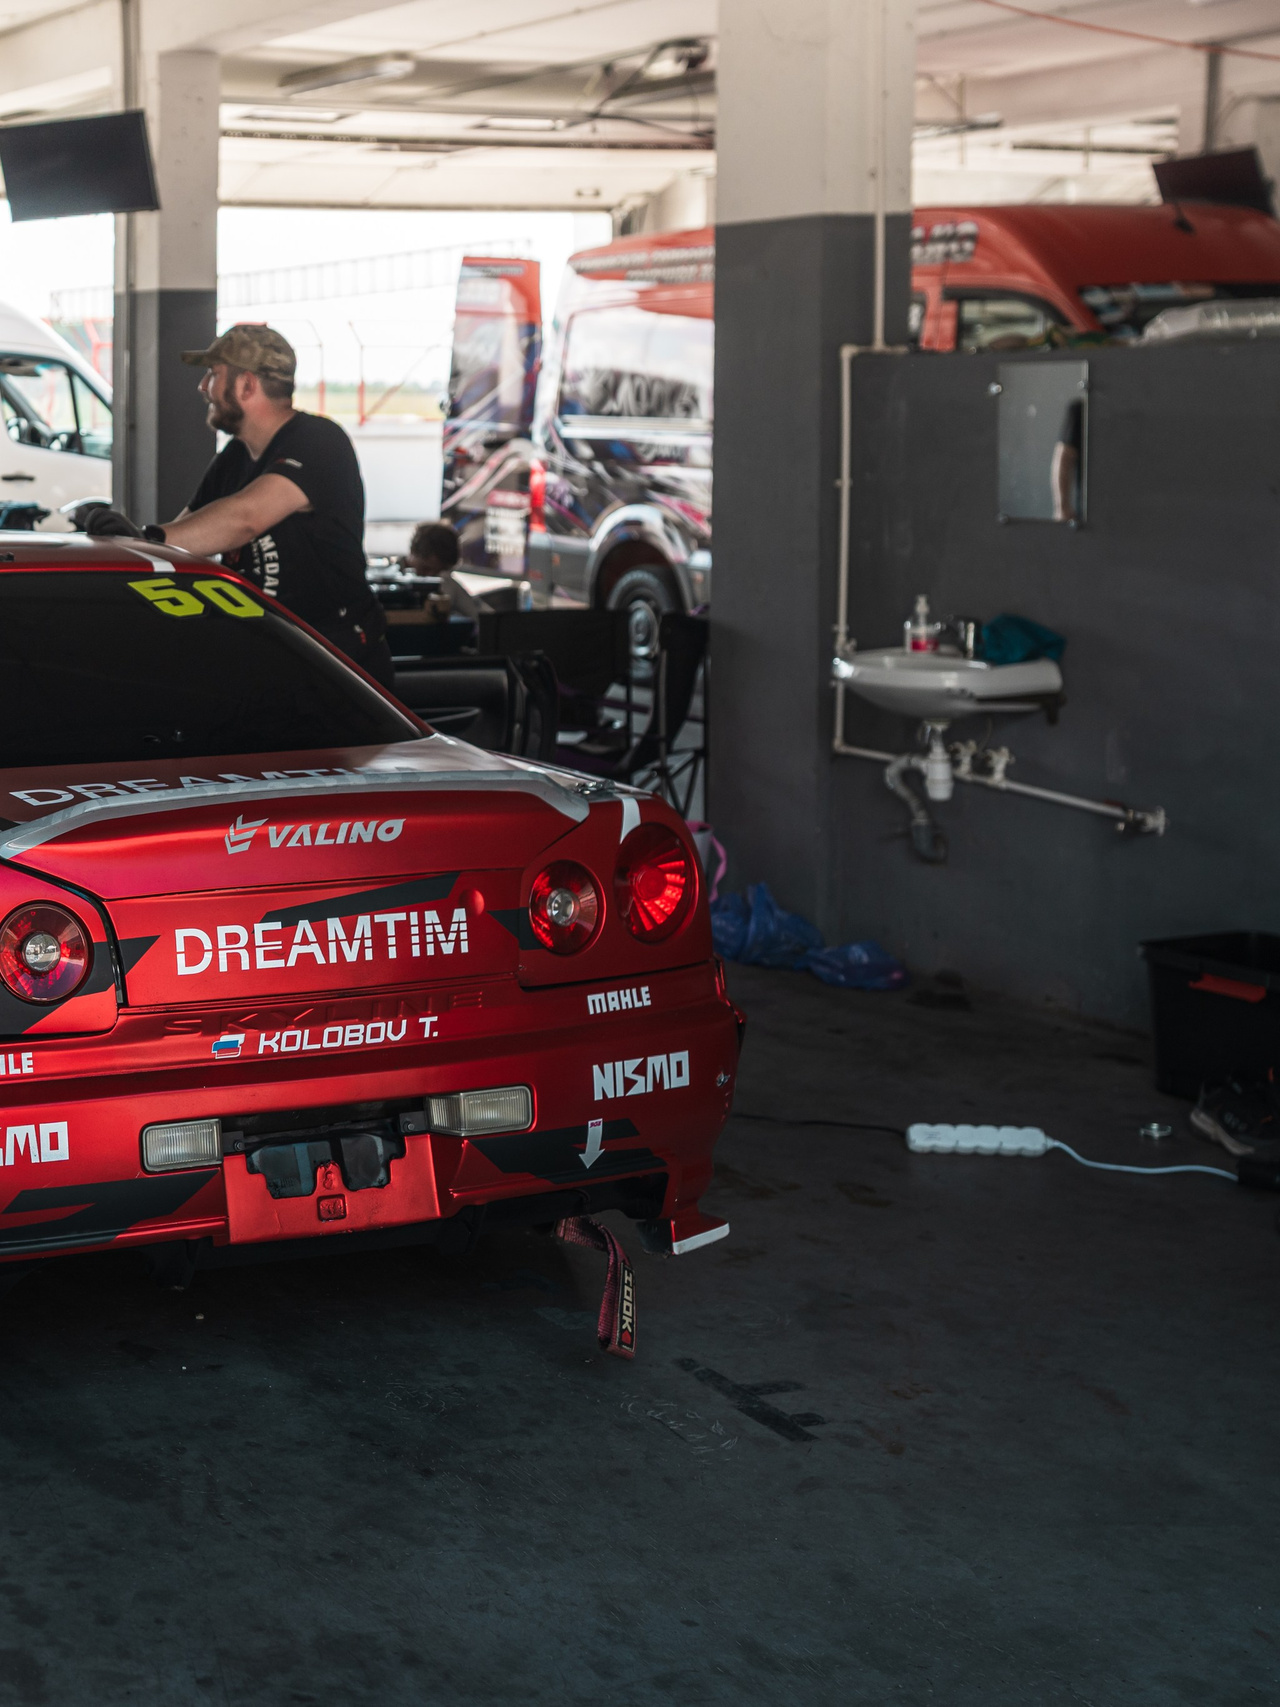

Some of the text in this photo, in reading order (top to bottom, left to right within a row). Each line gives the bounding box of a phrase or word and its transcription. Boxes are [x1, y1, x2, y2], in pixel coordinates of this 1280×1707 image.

[126, 577, 265, 619] 50
[269, 819, 410, 849] VALINO
[175, 907, 469, 976] DREAMTIM
[162, 991, 483, 1038] SKYLINE
[587, 985, 651, 1015] MAHLE
[257, 1015, 439, 1055] KOLOBOV T.
[592, 1050, 690, 1101] NISMO
